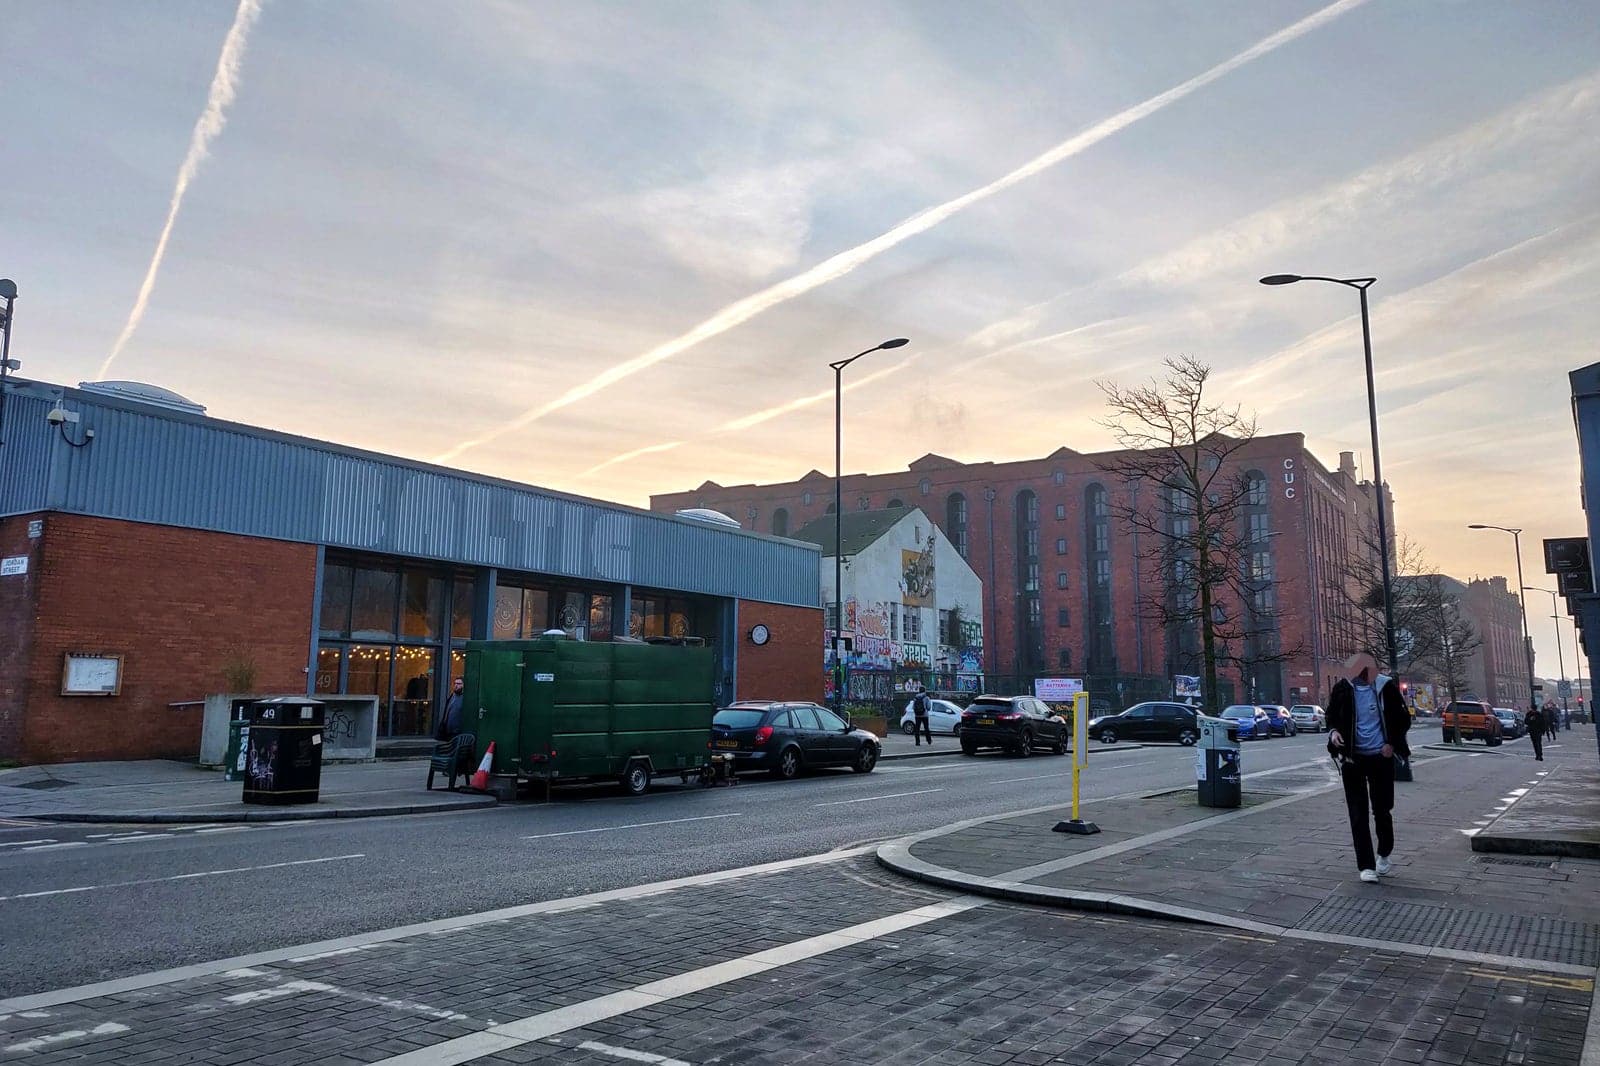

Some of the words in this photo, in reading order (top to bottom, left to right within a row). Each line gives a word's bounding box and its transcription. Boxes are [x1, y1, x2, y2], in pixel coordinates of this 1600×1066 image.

[1283, 458, 1296, 499] CUC
[2, 566, 20, 574] STREET
[317, 675, 332, 688] 49
[262, 708, 275, 719] 49
